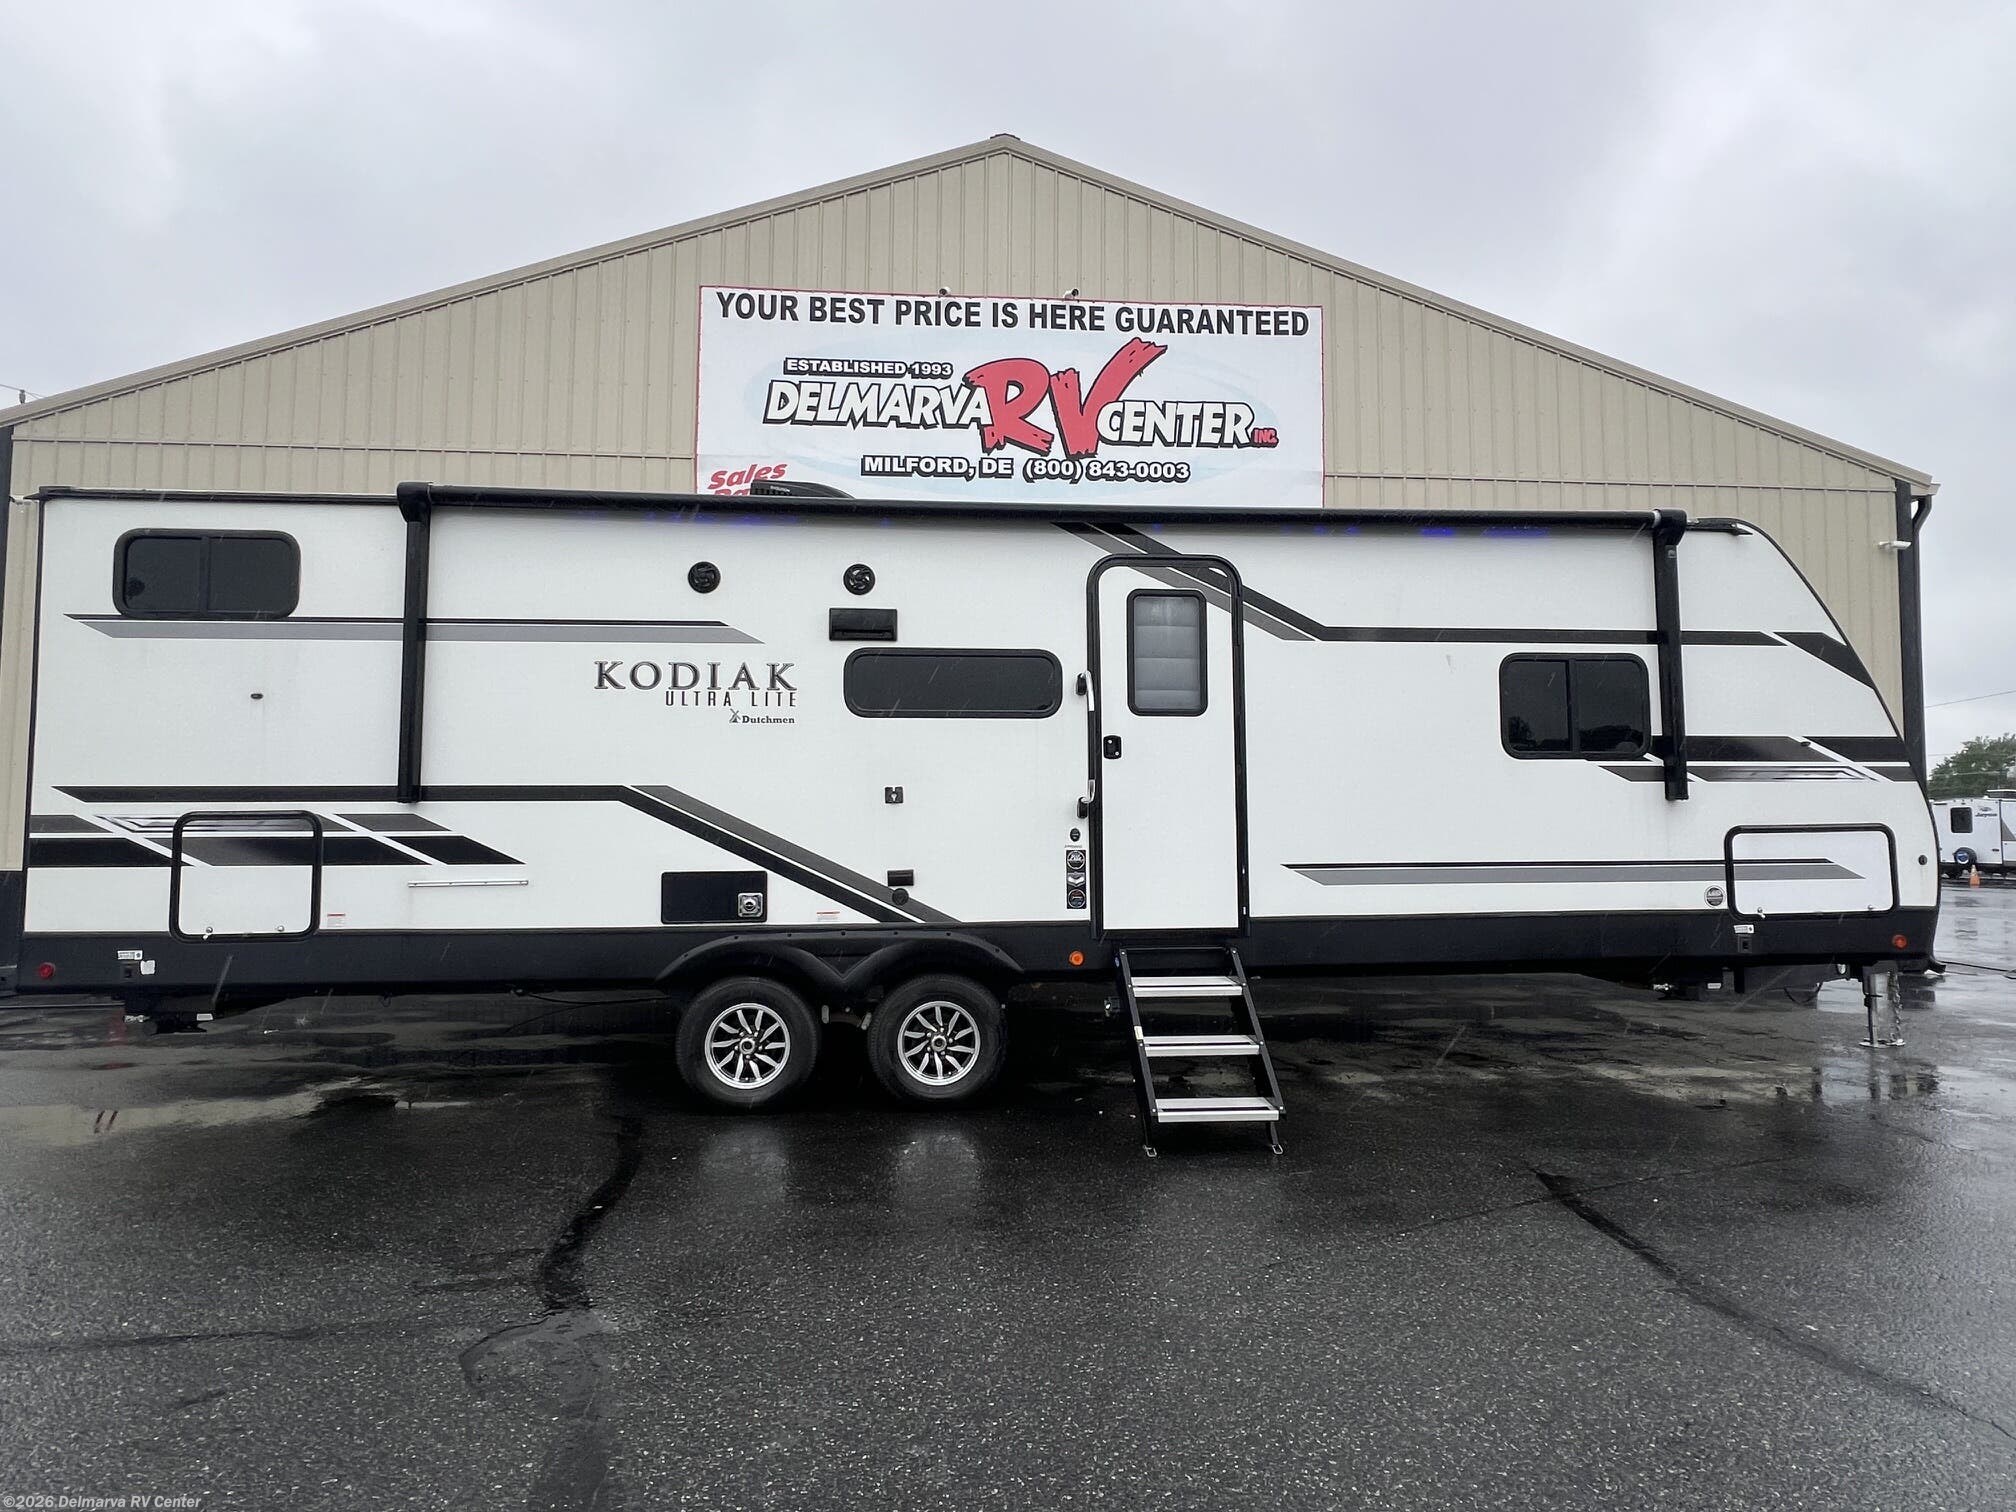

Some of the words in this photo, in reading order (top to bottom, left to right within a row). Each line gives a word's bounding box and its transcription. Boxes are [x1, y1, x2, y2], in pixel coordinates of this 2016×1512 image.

[716, 291, 799, 321] YOUR
[809, 296, 885, 324] BEST
[895, 300, 981, 327] PRICE
[992, 302, 1018, 328] IS
[1029, 303, 1105, 331] HERE
[1115, 306, 1310, 336] GUARANTEED
[784, 358, 906, 378] ESTABLISHED
[908, 362, 953, 379] 1993
[763, 380, 993, 429] DELMARVA
[962, 337, 1168, 459] RV
[1097, 400, 1254, 448] CENTER
[861, 455, 976, 482] MILFORD,
[978, 457, 1015, 477] DE
[1023, 458, 1084, 484] (800)
[1086, 460, 1191, 482] 843-0003
[593, 660, 798, 691] KODIAK
[665, 691, 732, 707] ULTRA
[751, 691, 797, 707] LITE
[742, 714, 796, 724] Dutchmen
